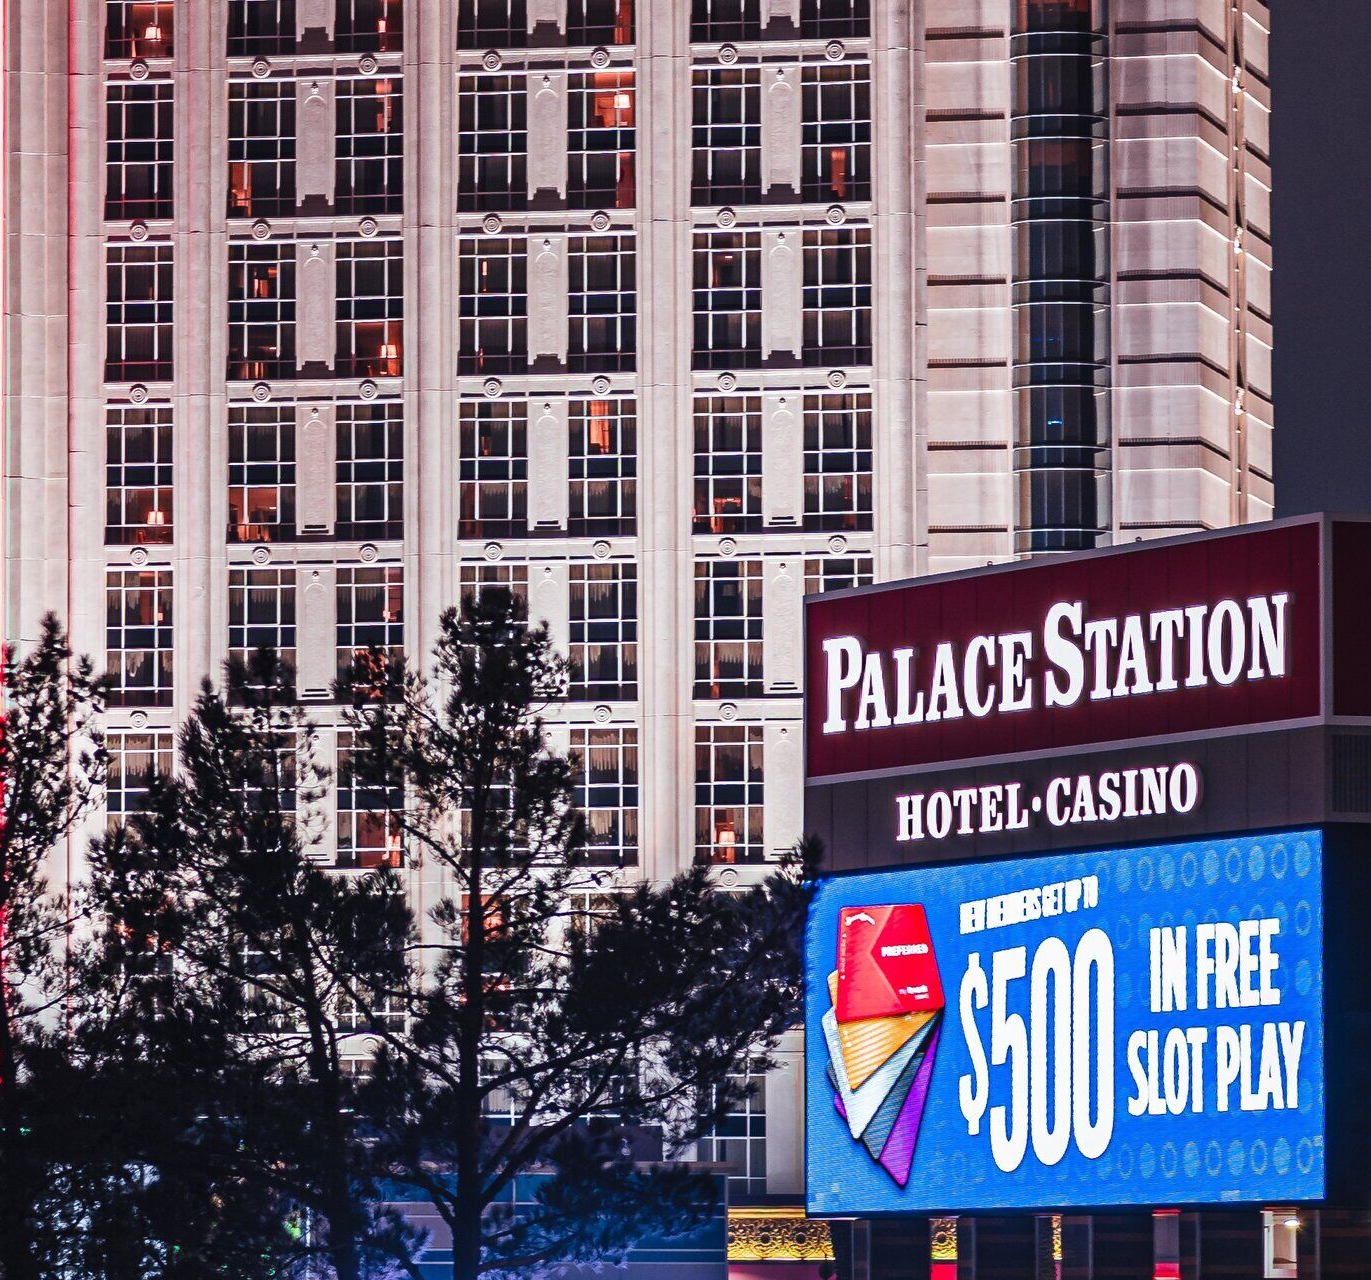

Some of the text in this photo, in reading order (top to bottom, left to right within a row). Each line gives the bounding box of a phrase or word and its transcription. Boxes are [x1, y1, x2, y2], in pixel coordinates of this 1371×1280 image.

[822, 592, 1290, 735] PALACE STATION
[1149, 917, 1281, 1013] IN FREE
[958, 927, 1115, 1173] $500
[1127, 1020, 1306, 1117] SLOT PLAY
